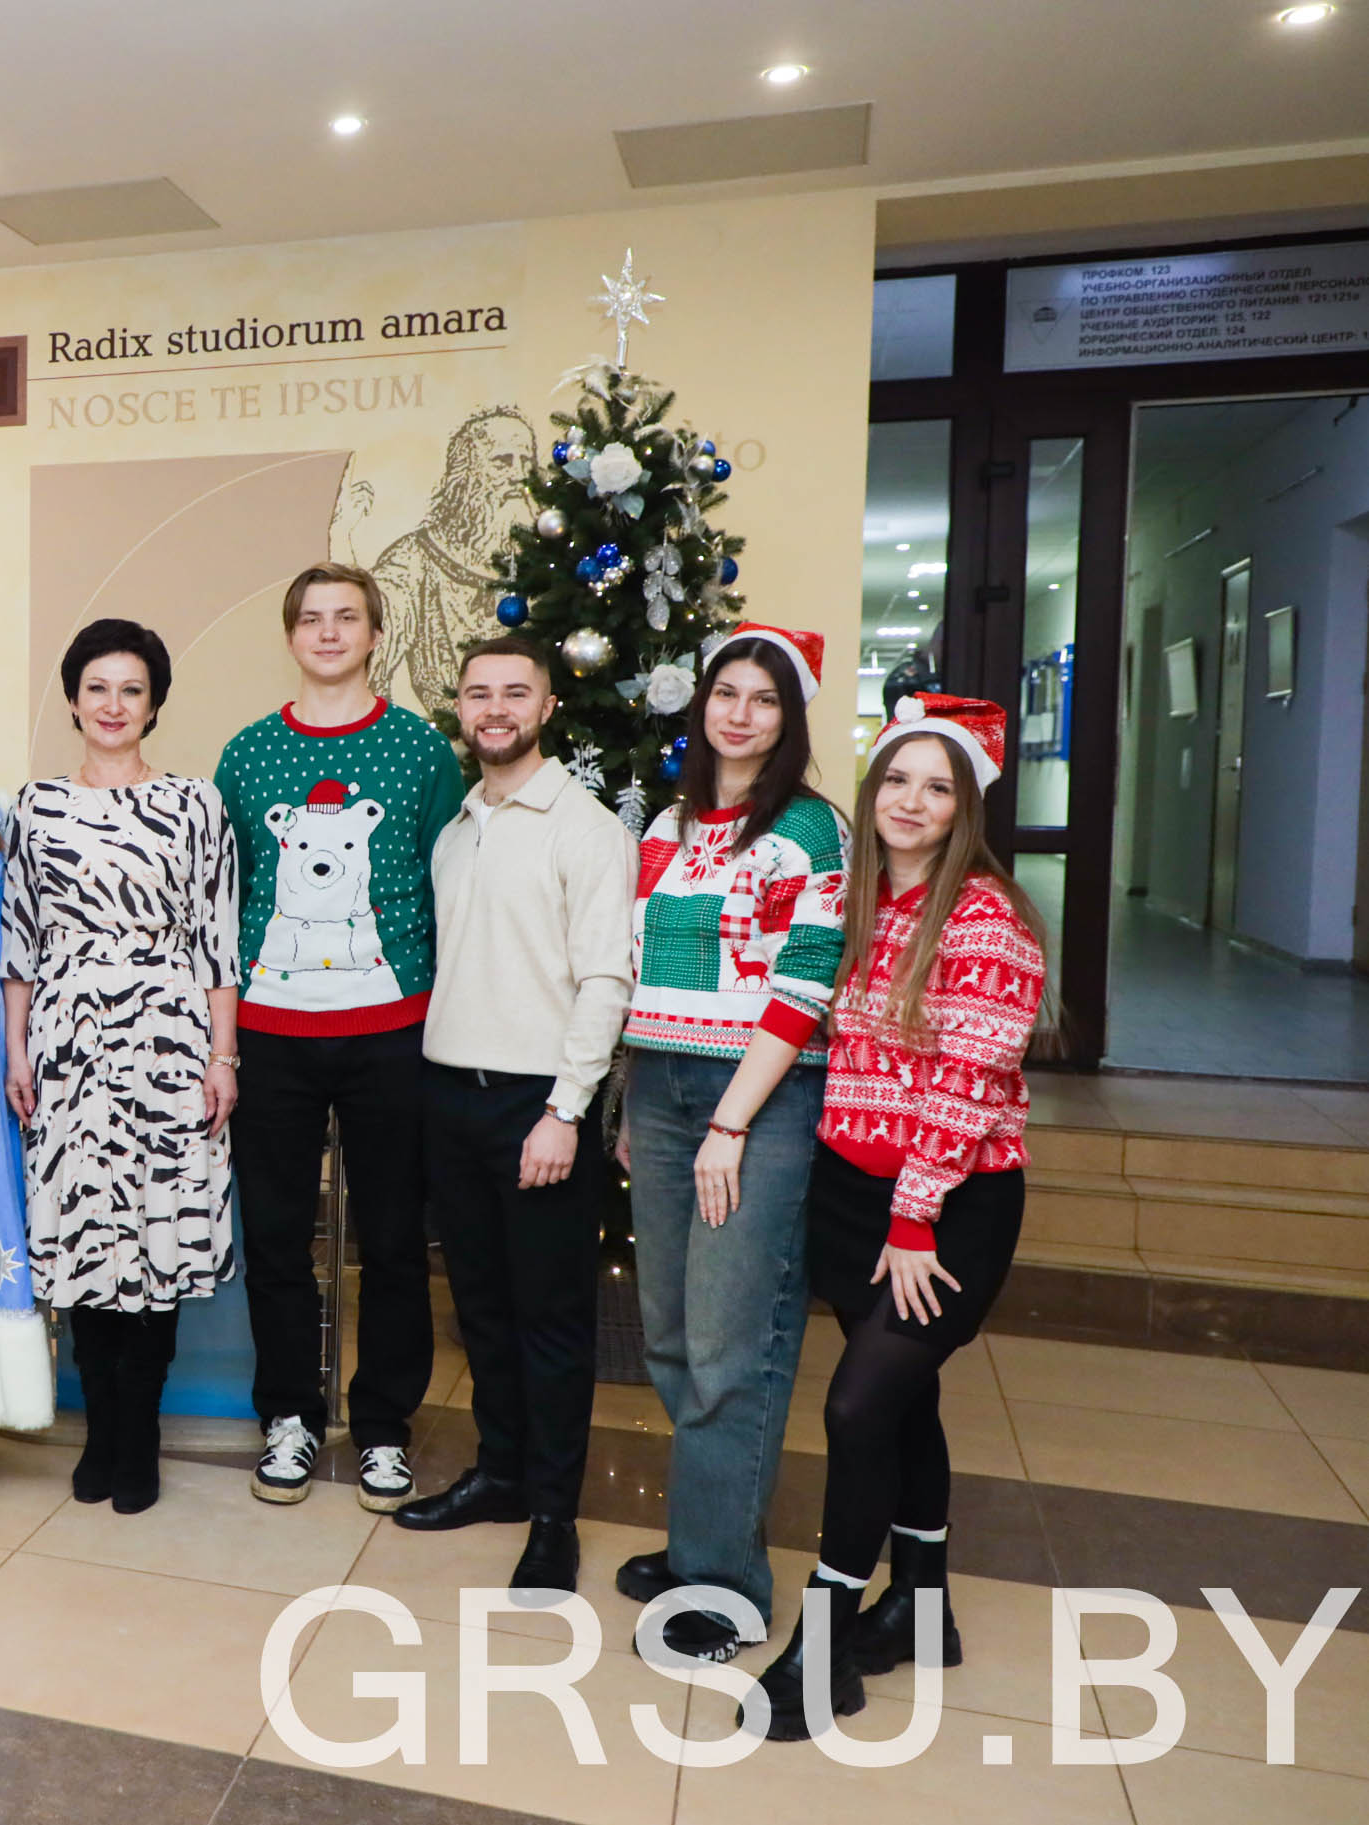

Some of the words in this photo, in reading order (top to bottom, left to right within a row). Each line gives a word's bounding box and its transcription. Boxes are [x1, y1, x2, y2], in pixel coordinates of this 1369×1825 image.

[1151, 264, 1171, 275] 123
[1268, 265, 1312, 279] ОТДЕЛ
[1081, 295, 1099, 306] ПО
[1102, 289, 1187, 305] УПРАВЛЕНИЮ
[1189, 282, 1291, 299] СТУДЕНЧЕСКИМ
[1080, 307, 1120, 320] ЦЕНТР
[1122, 299, 1237, 317] ОБЩЕСТВЕННОГО
[48, 327, 153, 363] Radix
[167, 317, 365, 356] studiorum
[381, 306, 508, 339] amara
[1079, 327, 1173, 344] ЮРИДИЧЕСКИЙ
[1227, 325, 1246, 335] 124
[1080, 319, 1139, 332] УЧЕБНЫЕ
[47, 388, 197, 430] NOSCE
[210, 383, 262, 421] TE
[278, 372, 425, 417] IPSUM
